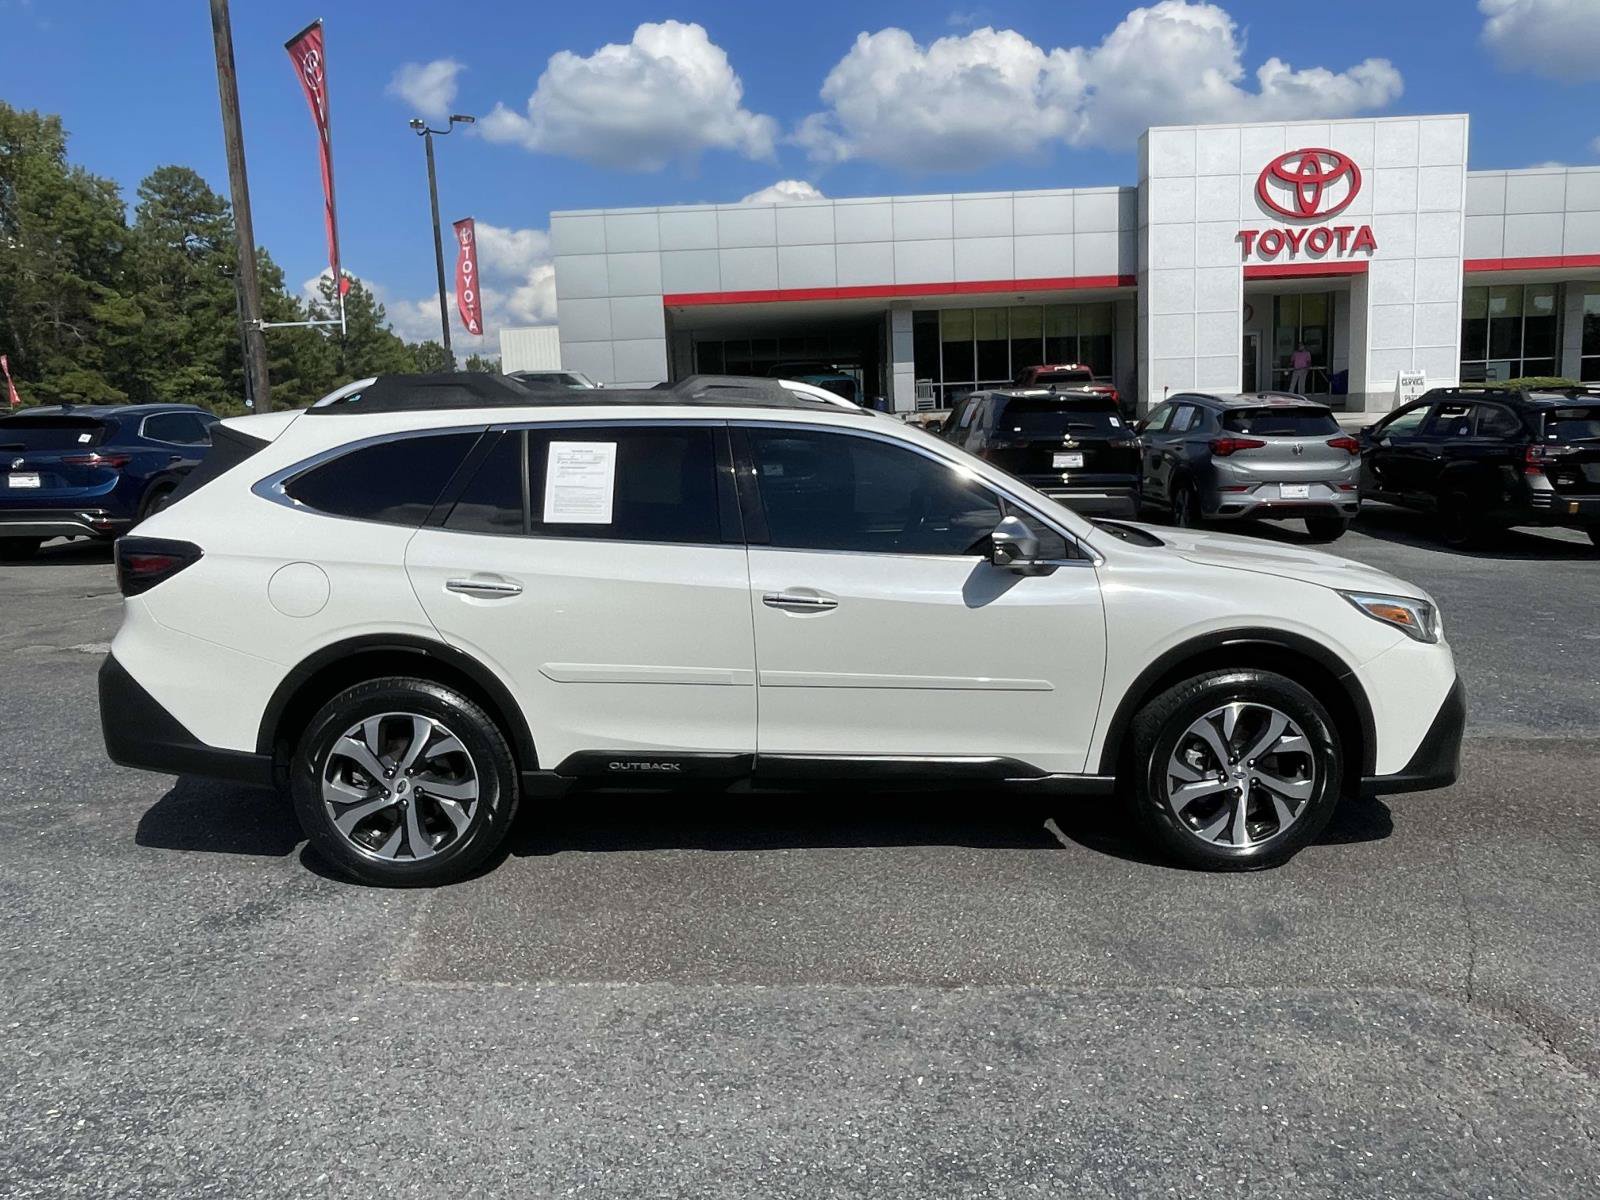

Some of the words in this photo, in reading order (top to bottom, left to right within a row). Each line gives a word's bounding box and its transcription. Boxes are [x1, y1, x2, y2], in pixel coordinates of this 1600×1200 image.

[1238, 225, 1378, 256] TOYOTA
[462, 246, 479, 332] TOYOTA
[608, 761, 681, 771] OUTBACK
